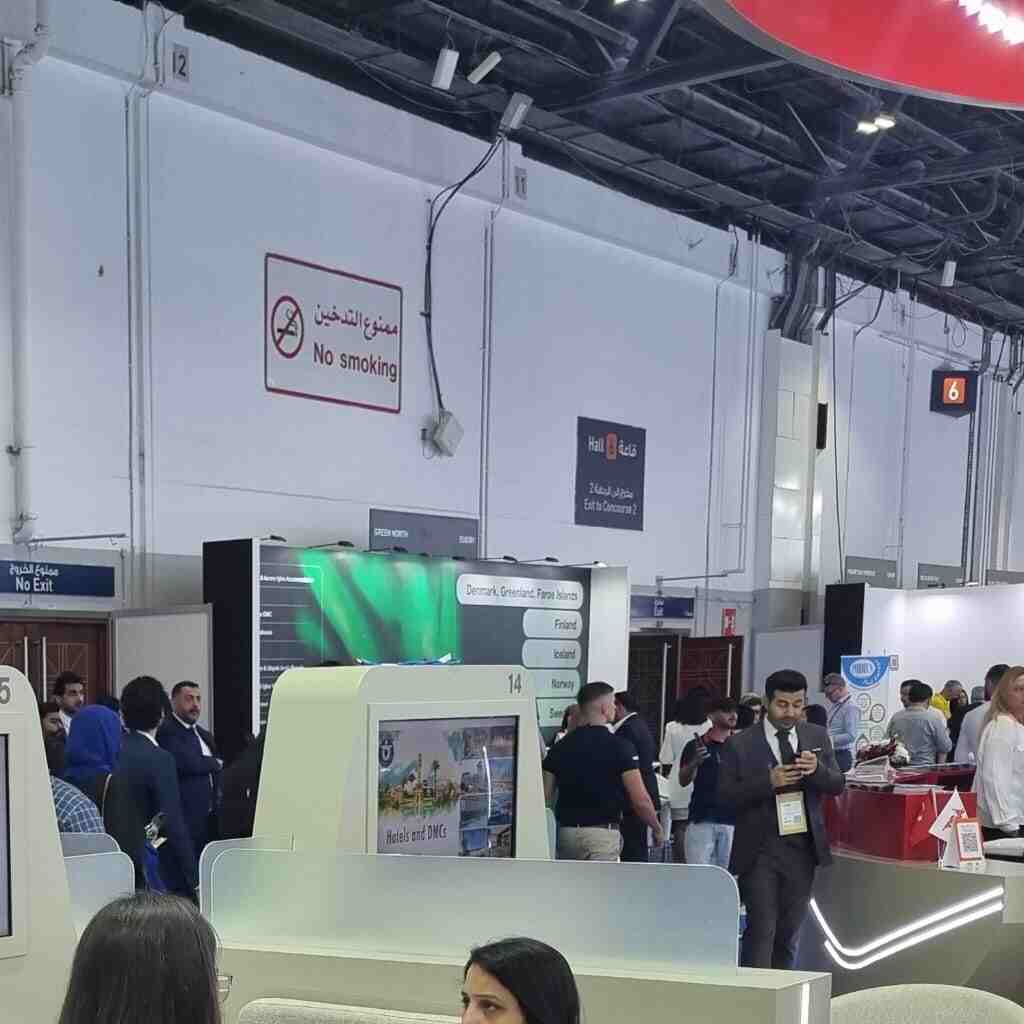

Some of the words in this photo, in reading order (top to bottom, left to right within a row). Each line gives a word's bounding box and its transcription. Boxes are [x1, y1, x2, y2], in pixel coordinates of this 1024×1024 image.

[314, 304, 362, 327] التدخين
[364, 315, 398, 340] ممنوع
[314, 342, 334, 366] No
[340, 352, 397, 383] smoking
[948, 380, 960, 401] 6
[588, 435, 605, 453] Hall
[9, 562, 34, 575] الخروج
[35, 564, 59, 577] ممنوع
[15, 576, 30, 591] No
[33, 577, 53, 593] Exit
[554, 619, 577, 630] Finland
[553, 648, 576, 659] Iceland
[508, 672, 522, 694] 14
[551, 678, 575, 692] Norway
[386, 827, 410, 844] Hotels
[412, 829, 426, 842] and
[428, 823, 447, 841] DMCs
